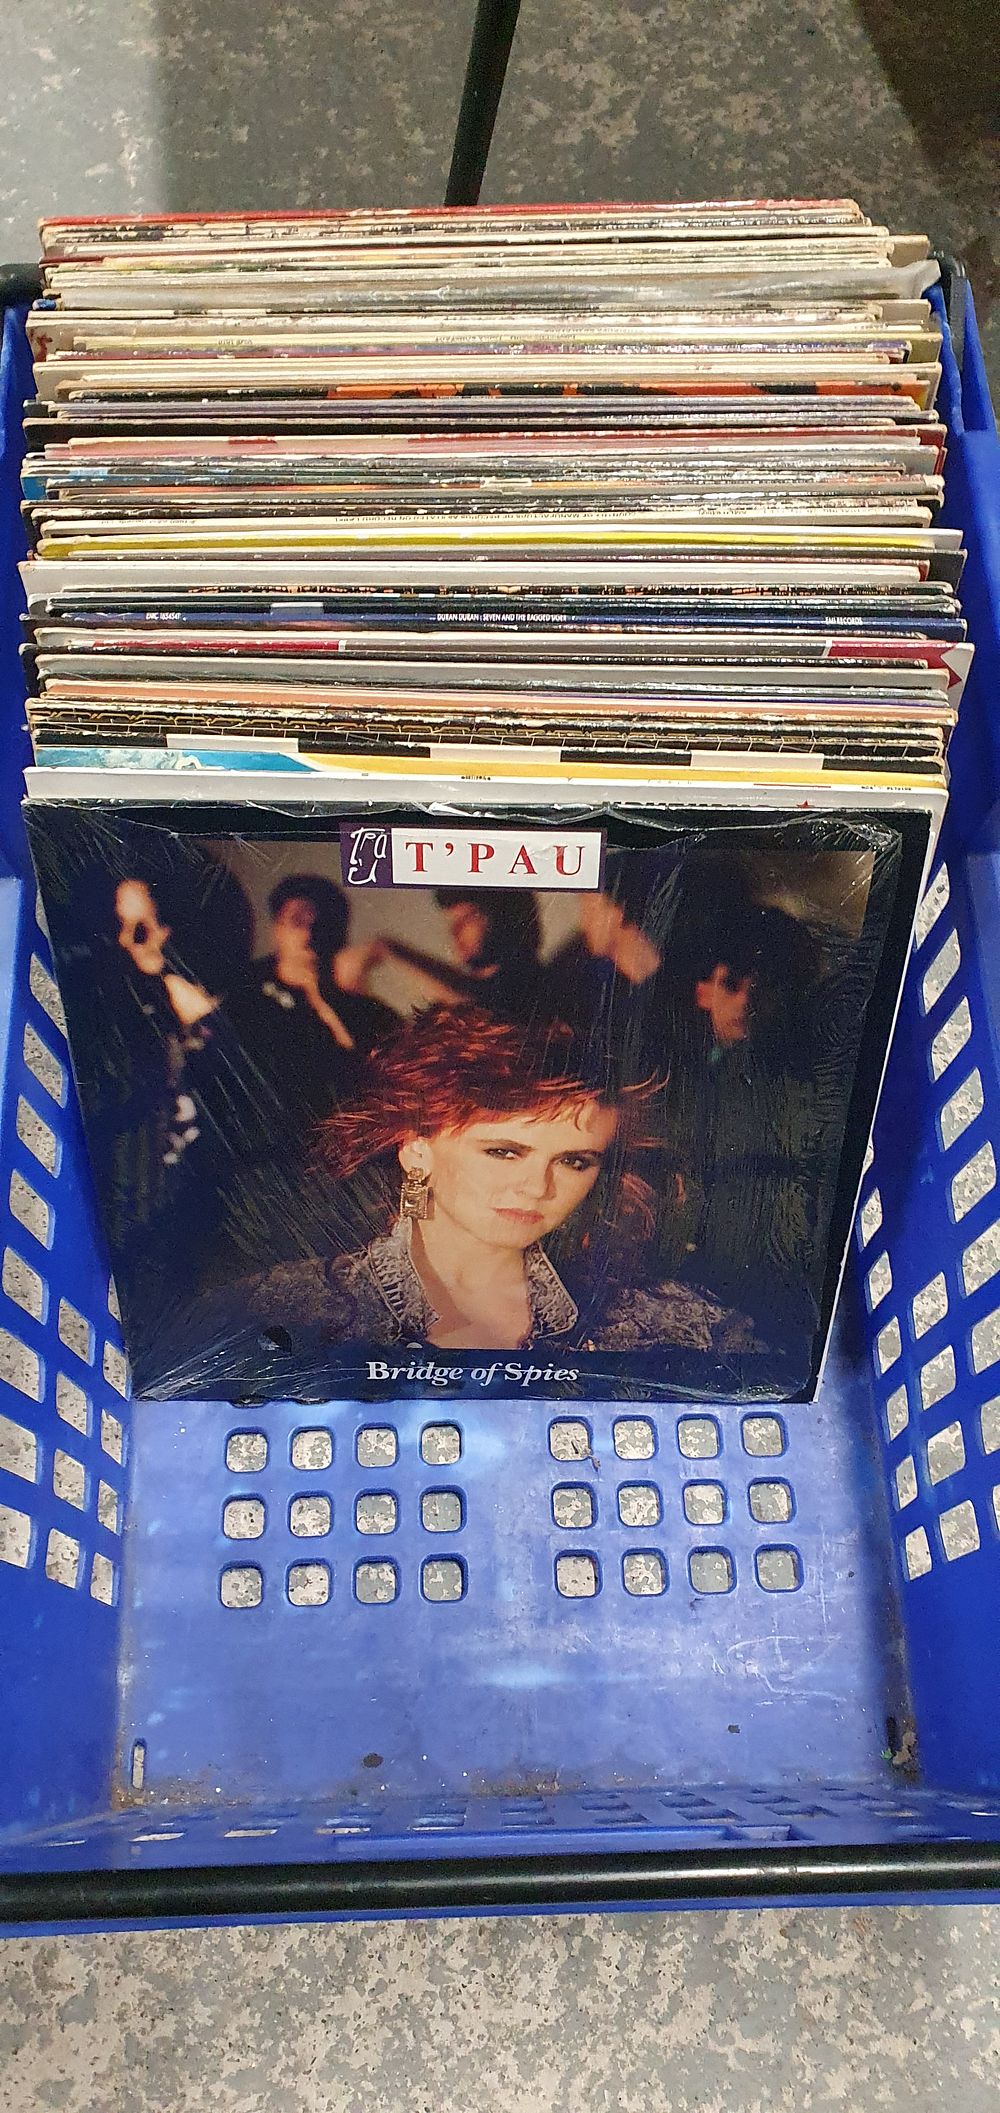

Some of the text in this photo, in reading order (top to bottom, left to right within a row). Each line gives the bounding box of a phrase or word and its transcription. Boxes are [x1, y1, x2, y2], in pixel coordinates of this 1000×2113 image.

[436, 613, 458, 622] DURAN
[458, 613, 479, 622] DURAN
[483, 613, 501, 622] SEVEN
[501, 613, 515, 622] AND
[526, 613, 551, 622] RAGGED
[836, 616, 863, 626] RECORDS
[405, 842, 586, 876] T'PAU
[365, 1361, 580, 1387] Bridge of Spies
